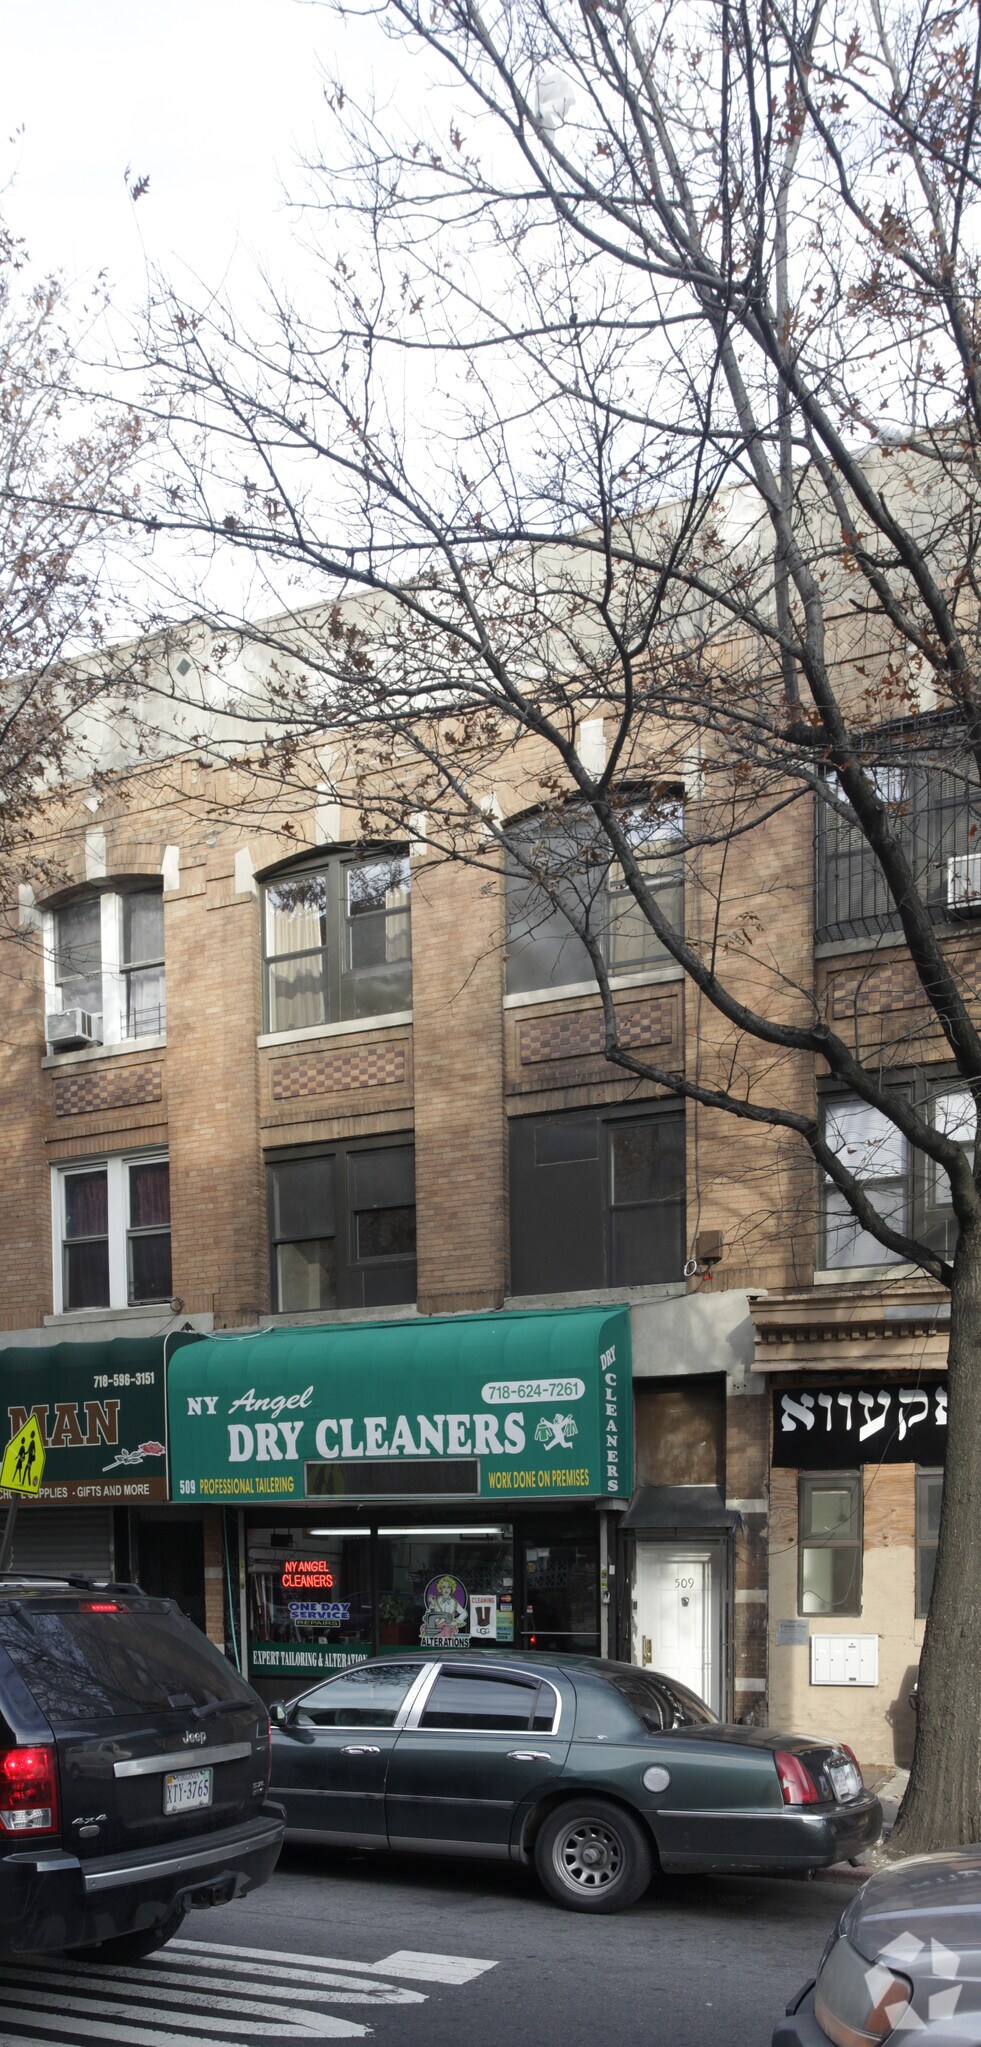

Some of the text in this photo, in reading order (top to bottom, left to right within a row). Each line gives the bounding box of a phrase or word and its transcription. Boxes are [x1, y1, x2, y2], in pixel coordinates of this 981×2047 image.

[93, 1371, 155, 1388] 718-596-3151
[488, 1382, 579, 1400] 718-624-7261
[187, 1385, 314, 1419] NY Angel
[7, 1399, 121, 1449] MAN
[600, 1345, 619, 1492] DRY CLEANERS
[227, 1412, 526, 1462] DRY CLEANERS
[180, 1476, 294, 1494] 509 PROFESSIONAL TAILERING
[488, 1469, 589, 1488] WORK DONE ON PREMISES
[77, 1486, 101, 1497] GIFTS
[103, 1485, 122, 1496] AND
[123, 1484, 150, 1495] MORE
[285, 1561, 329, 1572] NY ANGEL
[282, 1574, 333, 1587] CLEANERS
[674, 1578, 695, 1589] 509
[289, 1603, 350, 1611] ONE DAY
[421, 1637, 470, 1647] ALTERATIONS
[253, 1651, 280, 1665] EXPERT
[281, 1651, 317, 1667] TAILORING
[318, 1656, 323, 1666] &
[183, 1731, 206, 1744] Jeep
[167, 1779, 209, 1804] XTY-3765
